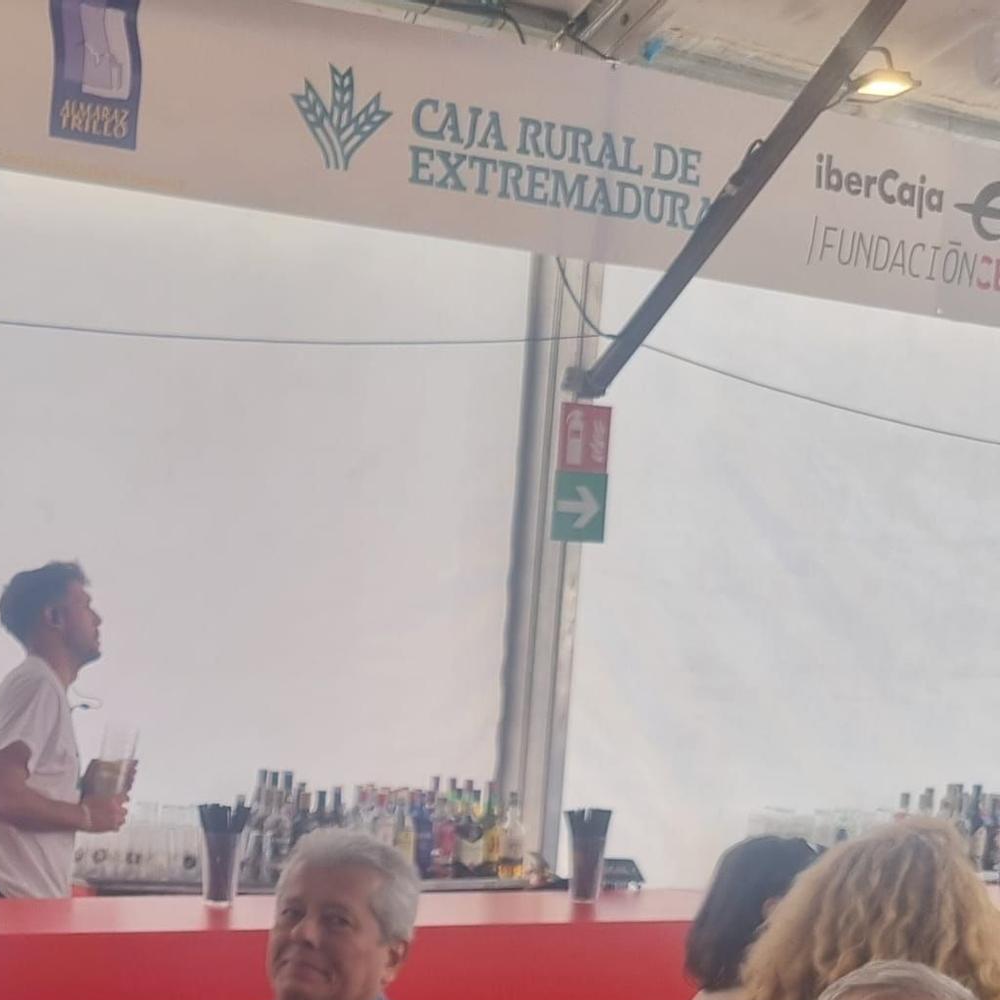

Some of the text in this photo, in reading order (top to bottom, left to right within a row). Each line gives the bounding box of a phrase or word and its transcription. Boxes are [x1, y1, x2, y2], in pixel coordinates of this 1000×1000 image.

[60, 98, 130, 122] ALMARAZ
[61, 115, 127, 139] TRILLO
[411, 98, 702, 187] CAJA RURAL DE
[815, 152, 945, 219] iberCaja
